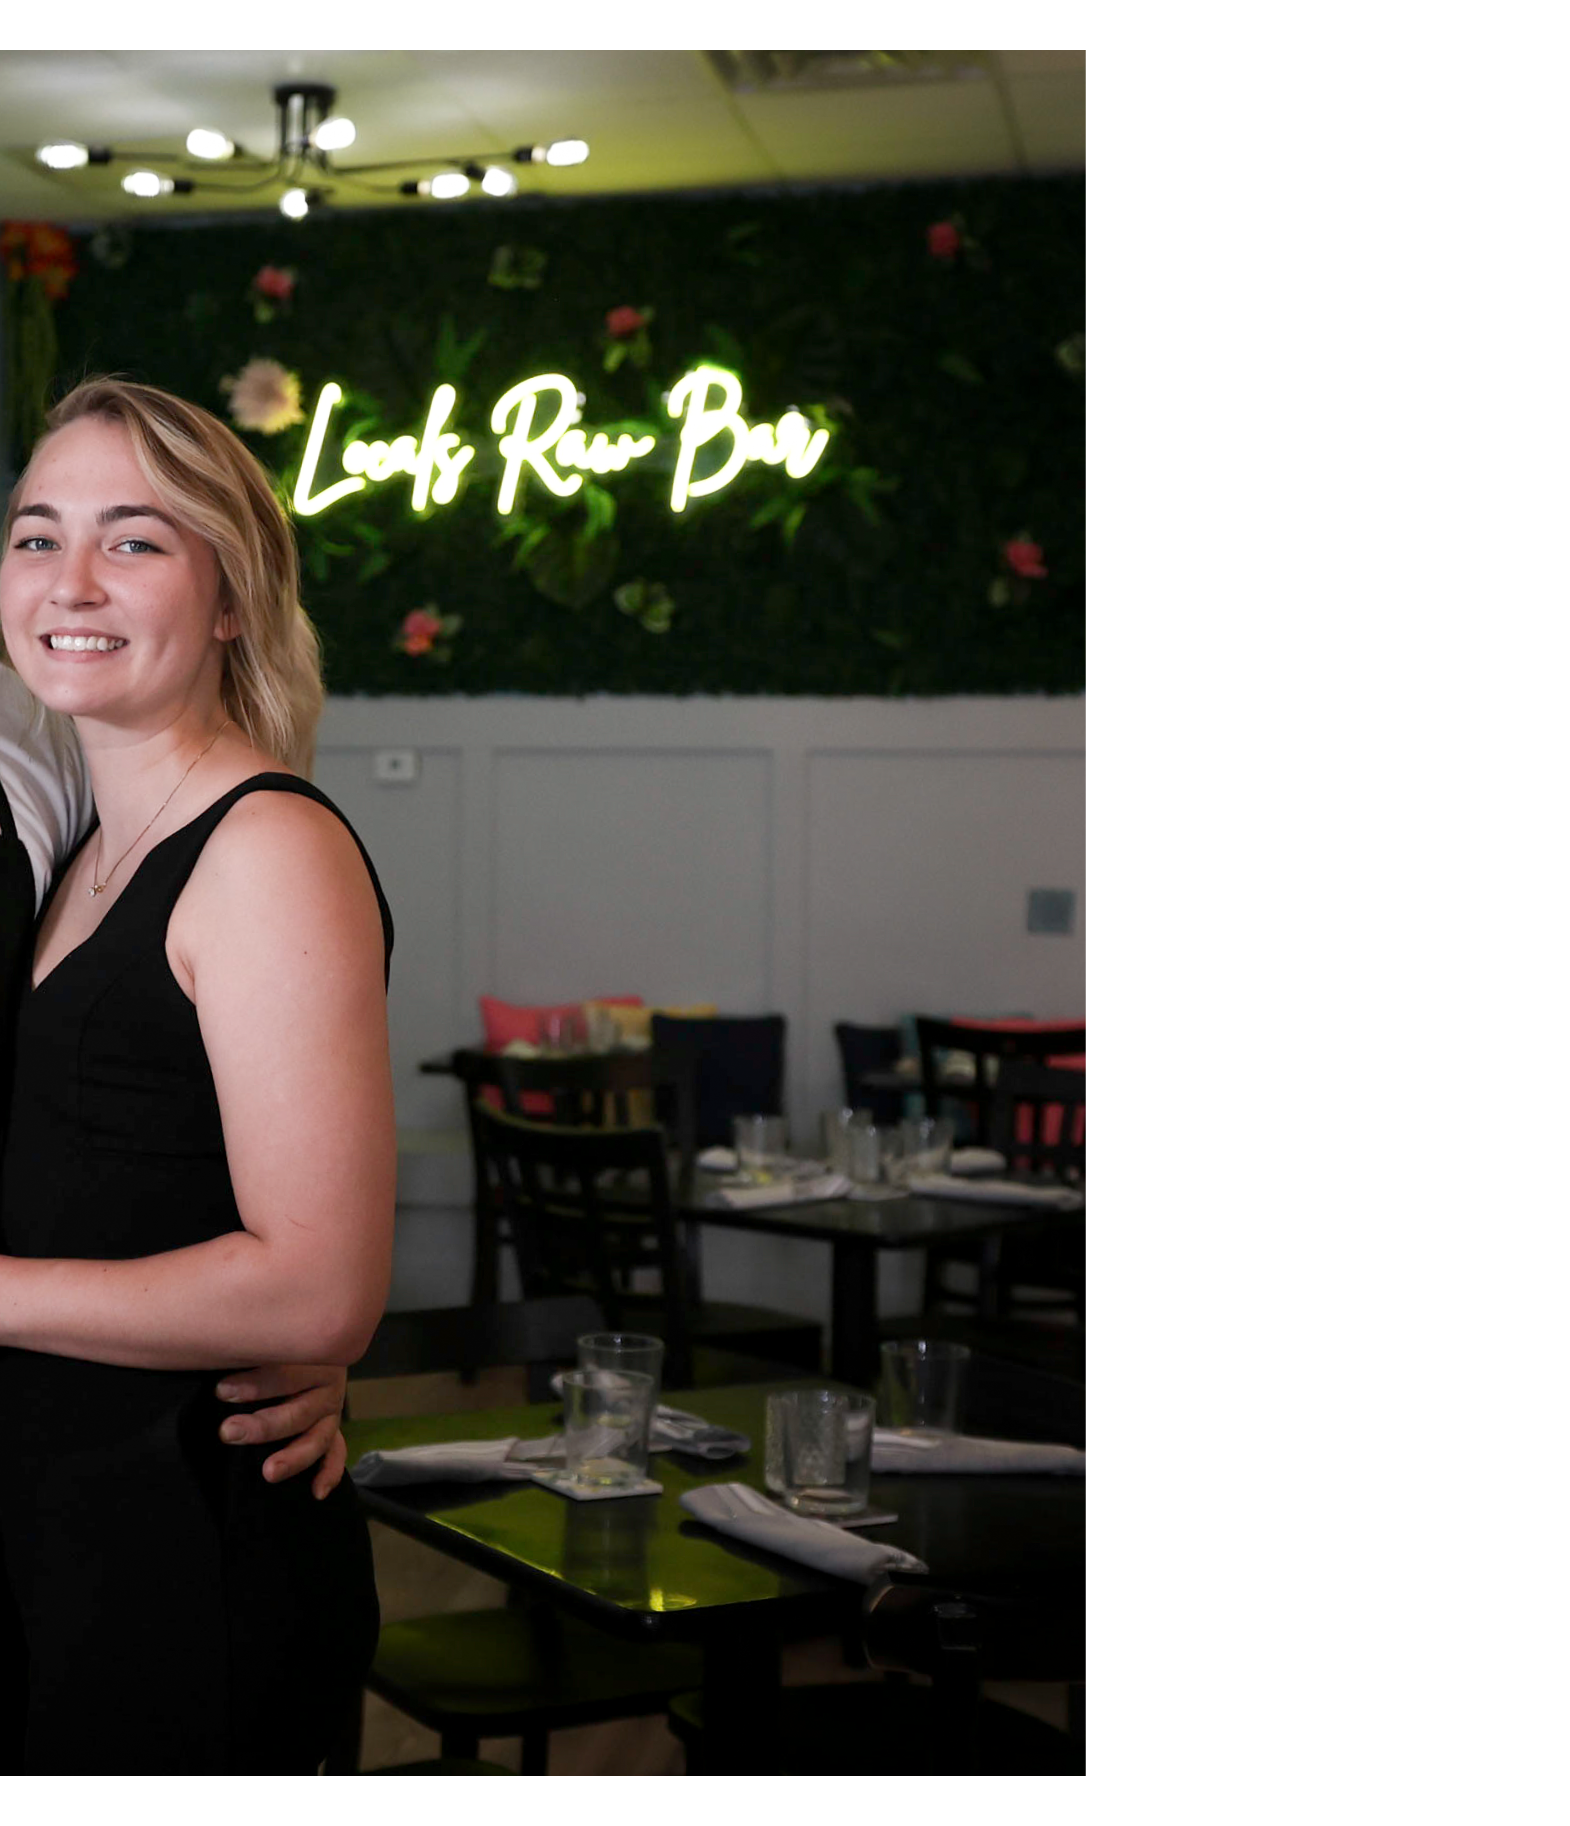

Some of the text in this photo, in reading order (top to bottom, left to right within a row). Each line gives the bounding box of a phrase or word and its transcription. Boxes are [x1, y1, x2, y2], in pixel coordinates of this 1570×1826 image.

[294, 365, 829, 516] Locals Raw Bar
